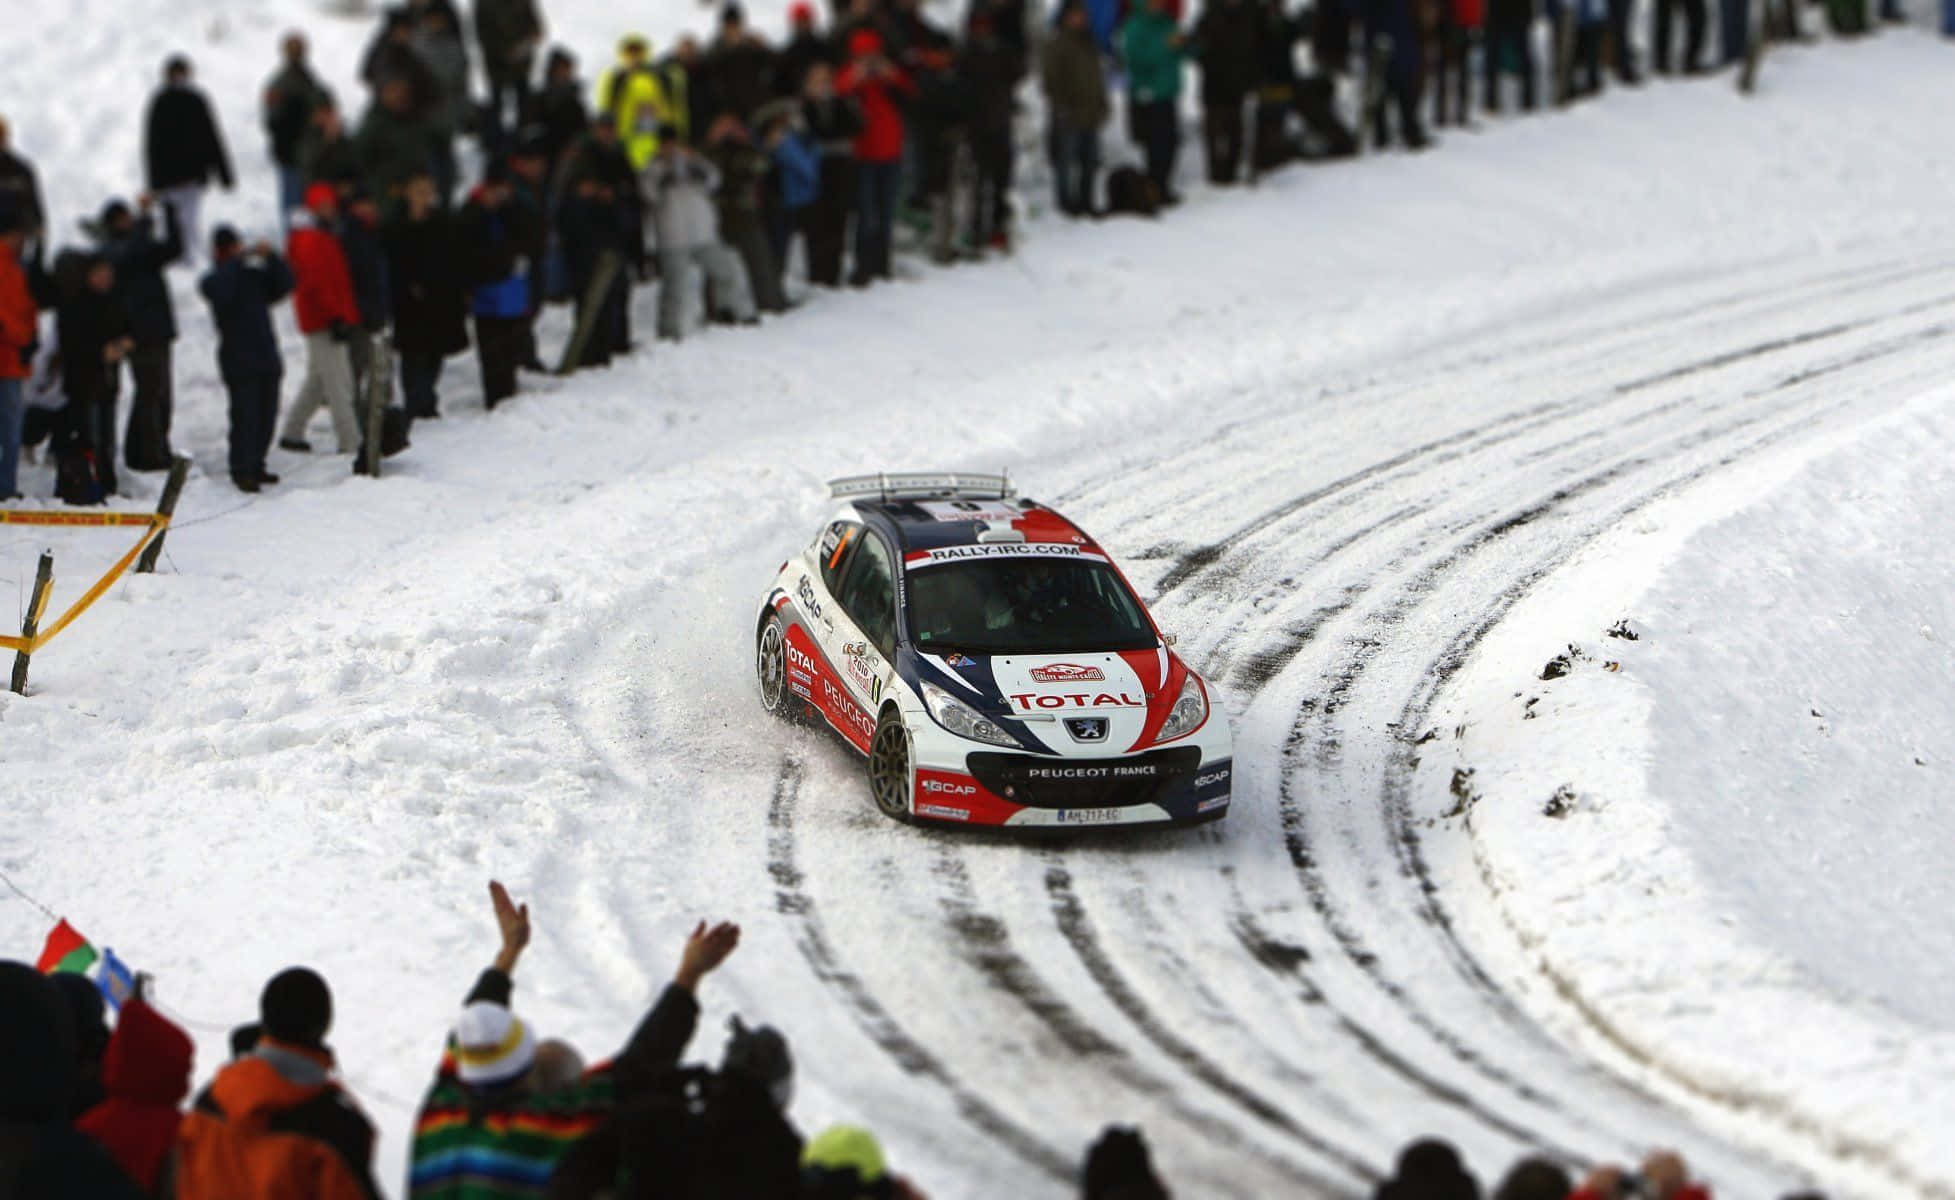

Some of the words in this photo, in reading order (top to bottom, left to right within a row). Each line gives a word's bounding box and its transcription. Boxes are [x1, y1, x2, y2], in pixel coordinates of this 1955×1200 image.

[932, 544, 1080, 561] RALLY-IRC.COM
[785, 638, 818, 675] TOTAL
[1010, 693, 1143, 710] TOTAL
[1029, 768, 1109, 778] PEUGEOT
[1114, 765, 1156, 776] FRANCE
